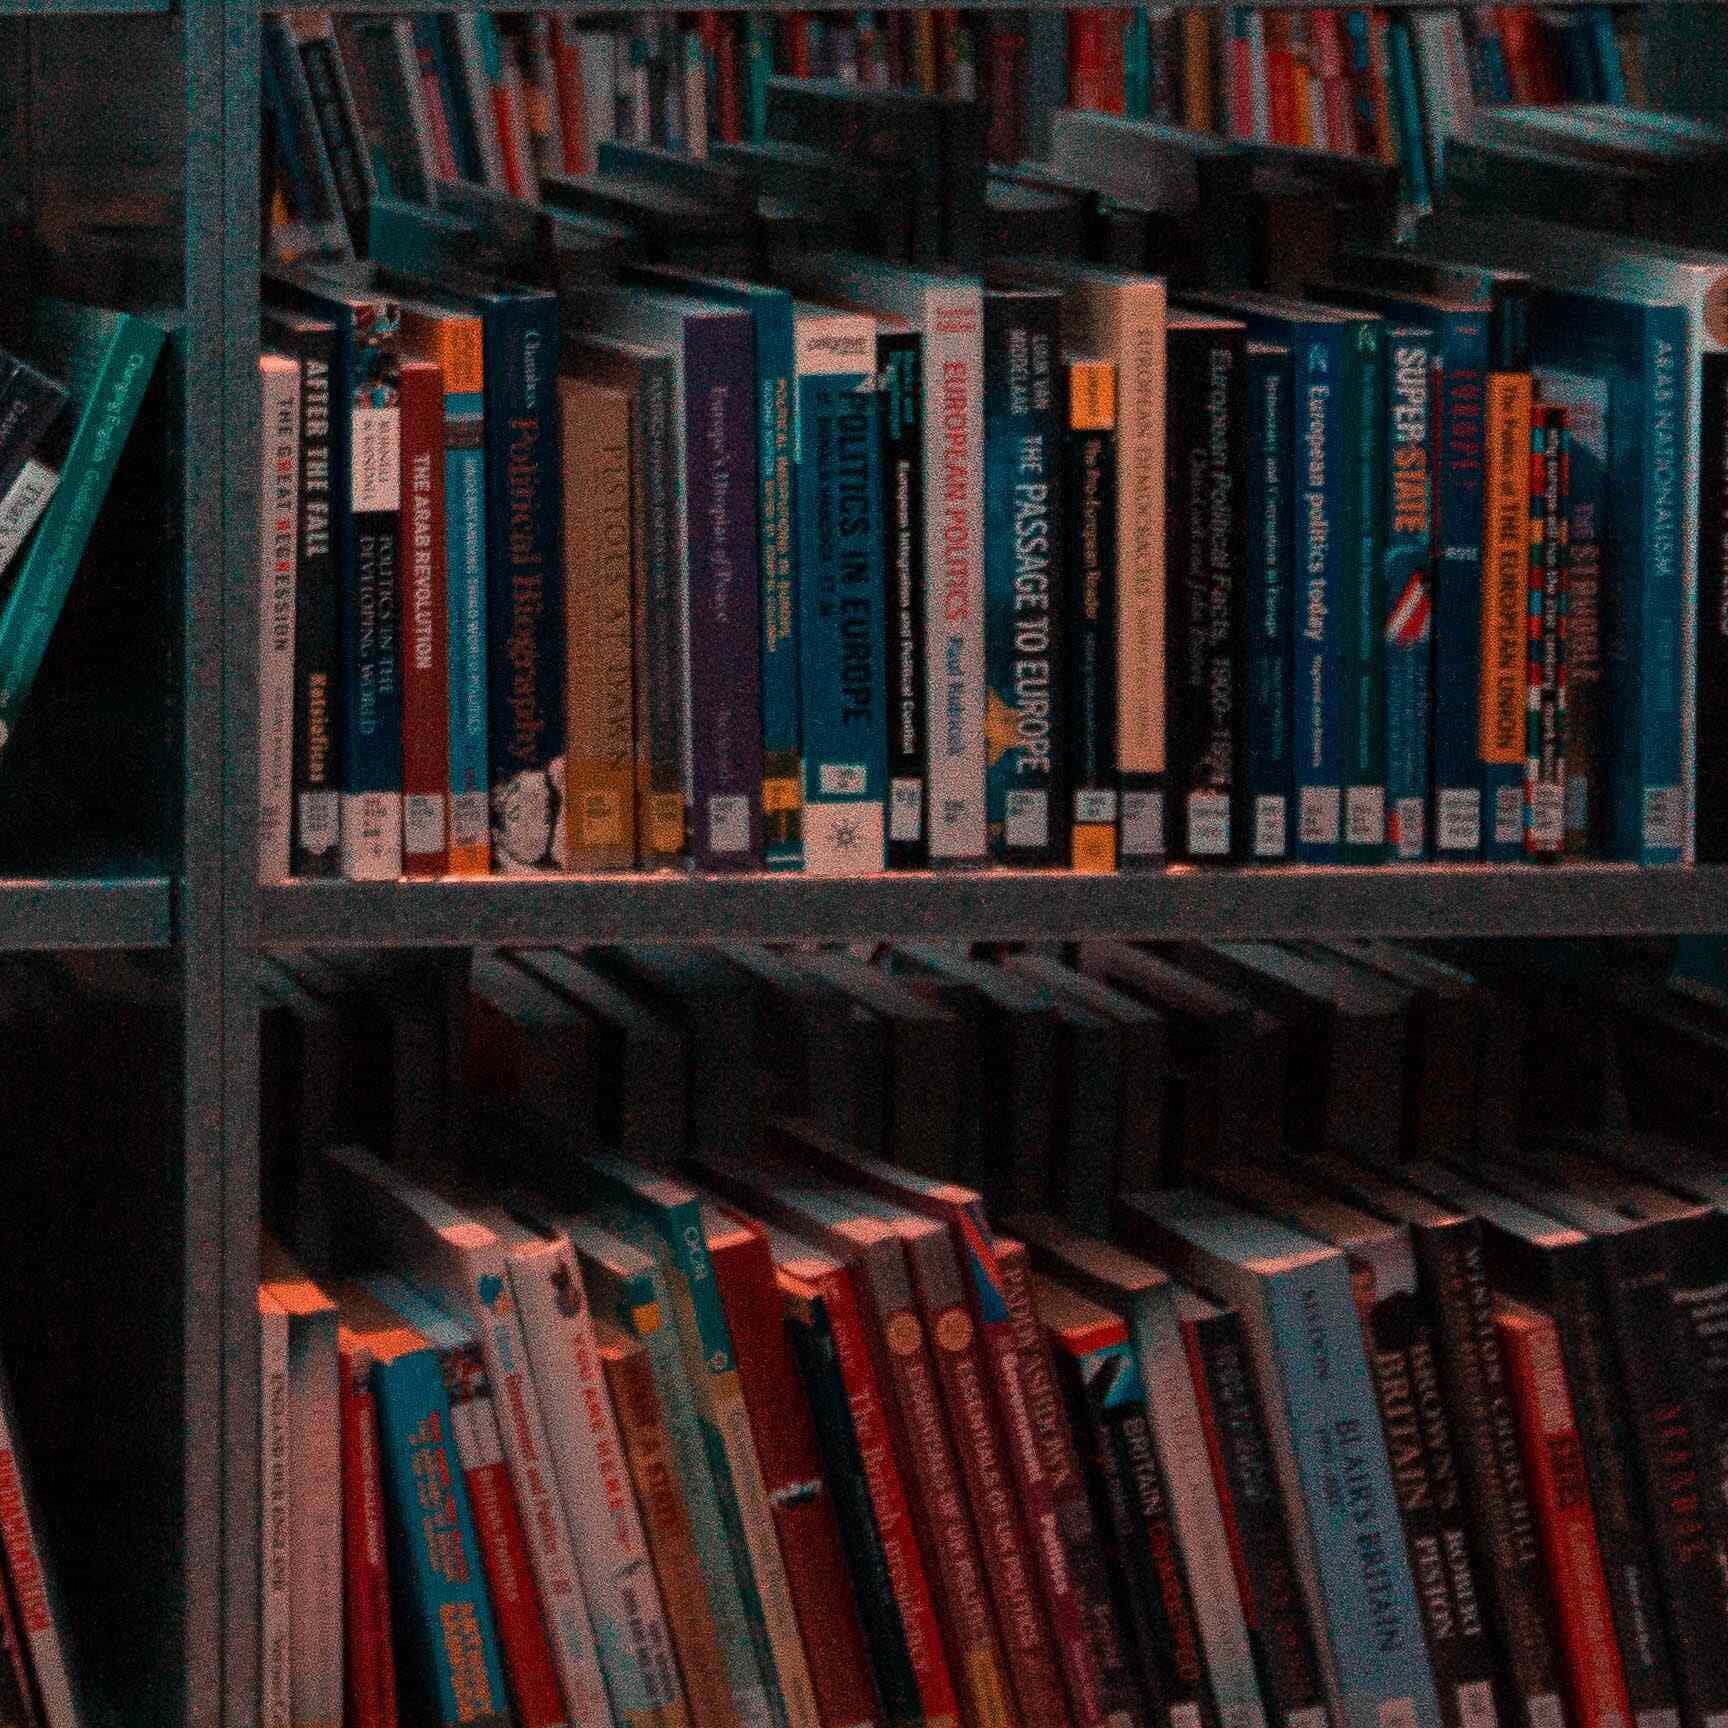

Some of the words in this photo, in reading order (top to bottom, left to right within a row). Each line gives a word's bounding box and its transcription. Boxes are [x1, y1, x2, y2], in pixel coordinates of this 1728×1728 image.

[306, 359, 328, 437] AFTER
[943, 362, 968, 501] EUROPEAN
[1307, 385, 1330, 486] European
[306, 446, 328, 492] THE
[414, 454, 431, 489] THE
[1020, 435, 1042, 472] THE
[306, 501, 328, 557] FALL
[414, 494, 431, 547] ARAB
[1015, 483, 1050, 610] PASSAGE
[1305, 493, 1330, 571] politics
[944, 510, 968, 621] POLITICS
[414, 552, 431, 670] REVOLUTION
[1016, 617, 1050, 654] TO
[1305, 578, 1330, 642] today
[1016, 661, 1050, 772] EUROPE
[956, 1360, 1003, 1488] ESSENTIALS
[988, 1494, 1010, 1518] OF
[1339, 1420, 1385, 1525] BLAIR'S
[994, 1523, 1018, 1550] UK
[1001, 1555, 1040, 1649] POLITICS
[1357, 1532, 1402, 1652] BRITAIN
